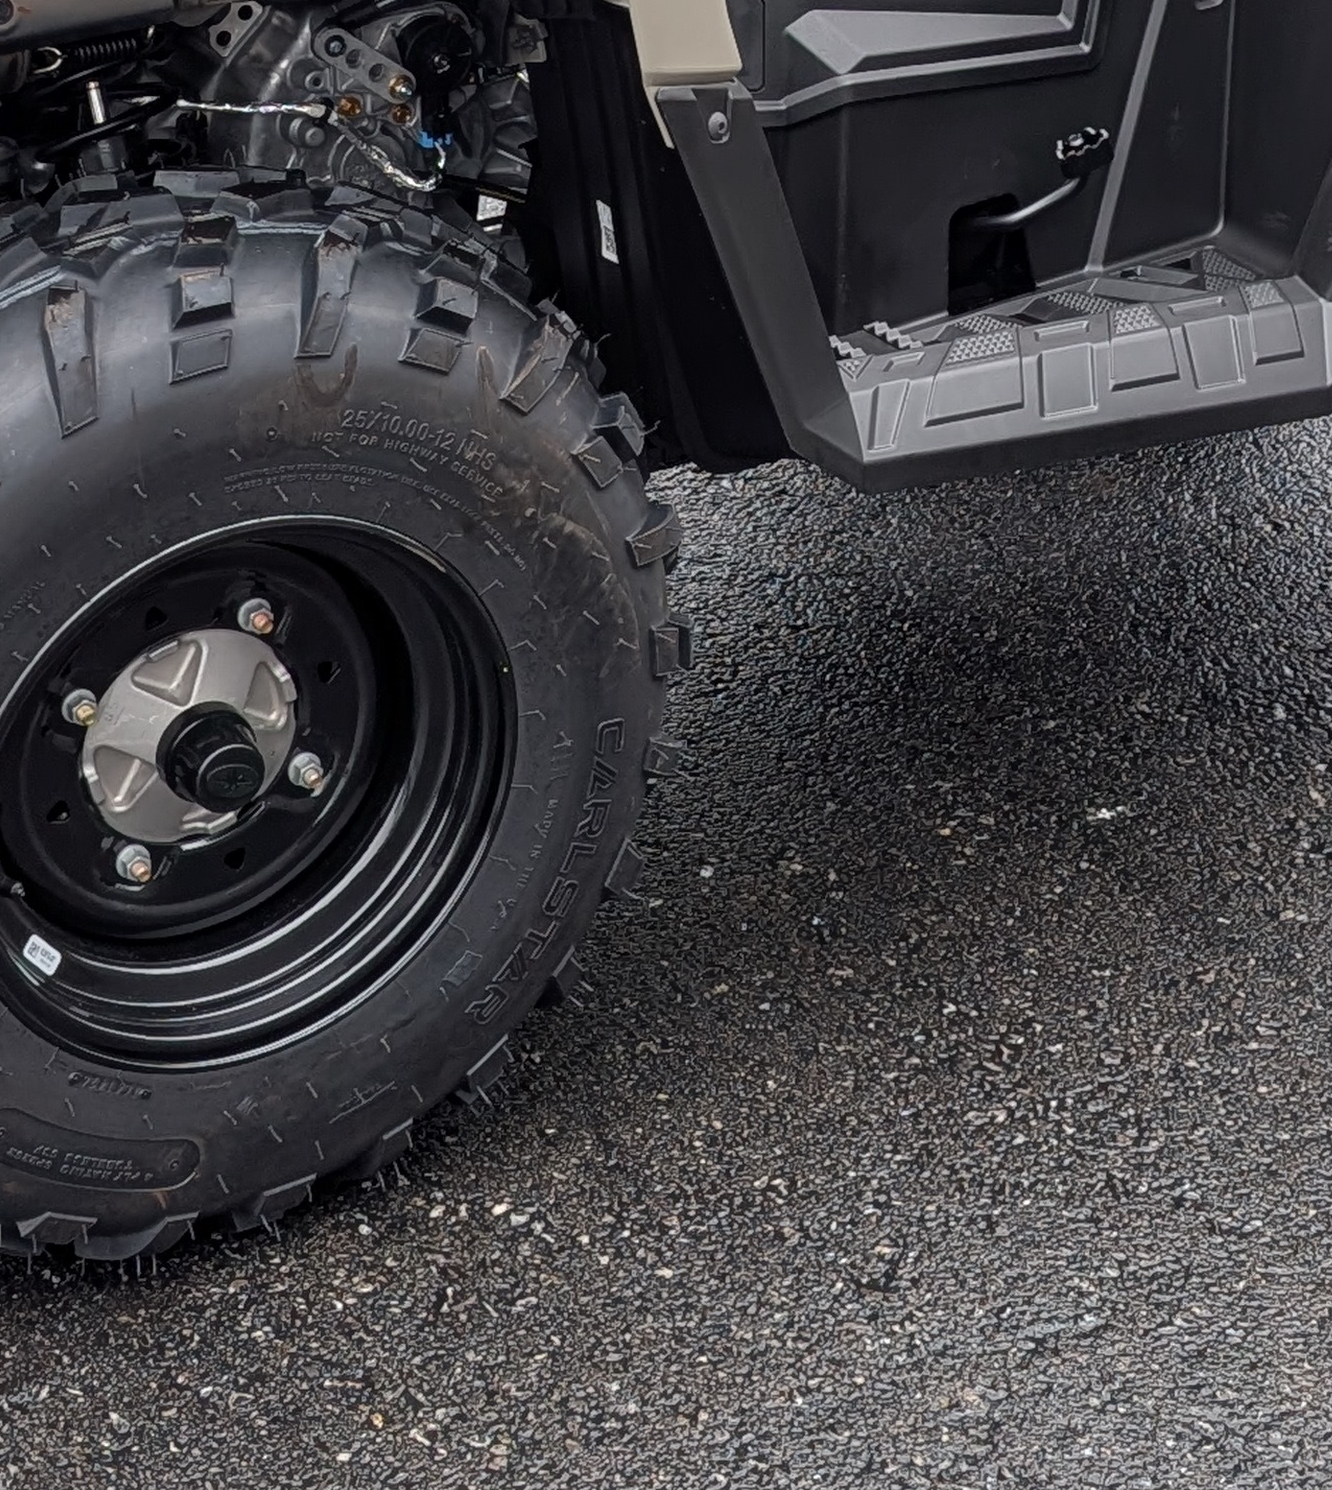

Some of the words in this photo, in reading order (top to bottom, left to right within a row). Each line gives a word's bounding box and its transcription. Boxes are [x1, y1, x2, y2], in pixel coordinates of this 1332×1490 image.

[383, 438, 448, 467] HIGHWAY
[456, 436, 498, 472] NHS
[464, 716, 626, 1025] CARLSTAR
